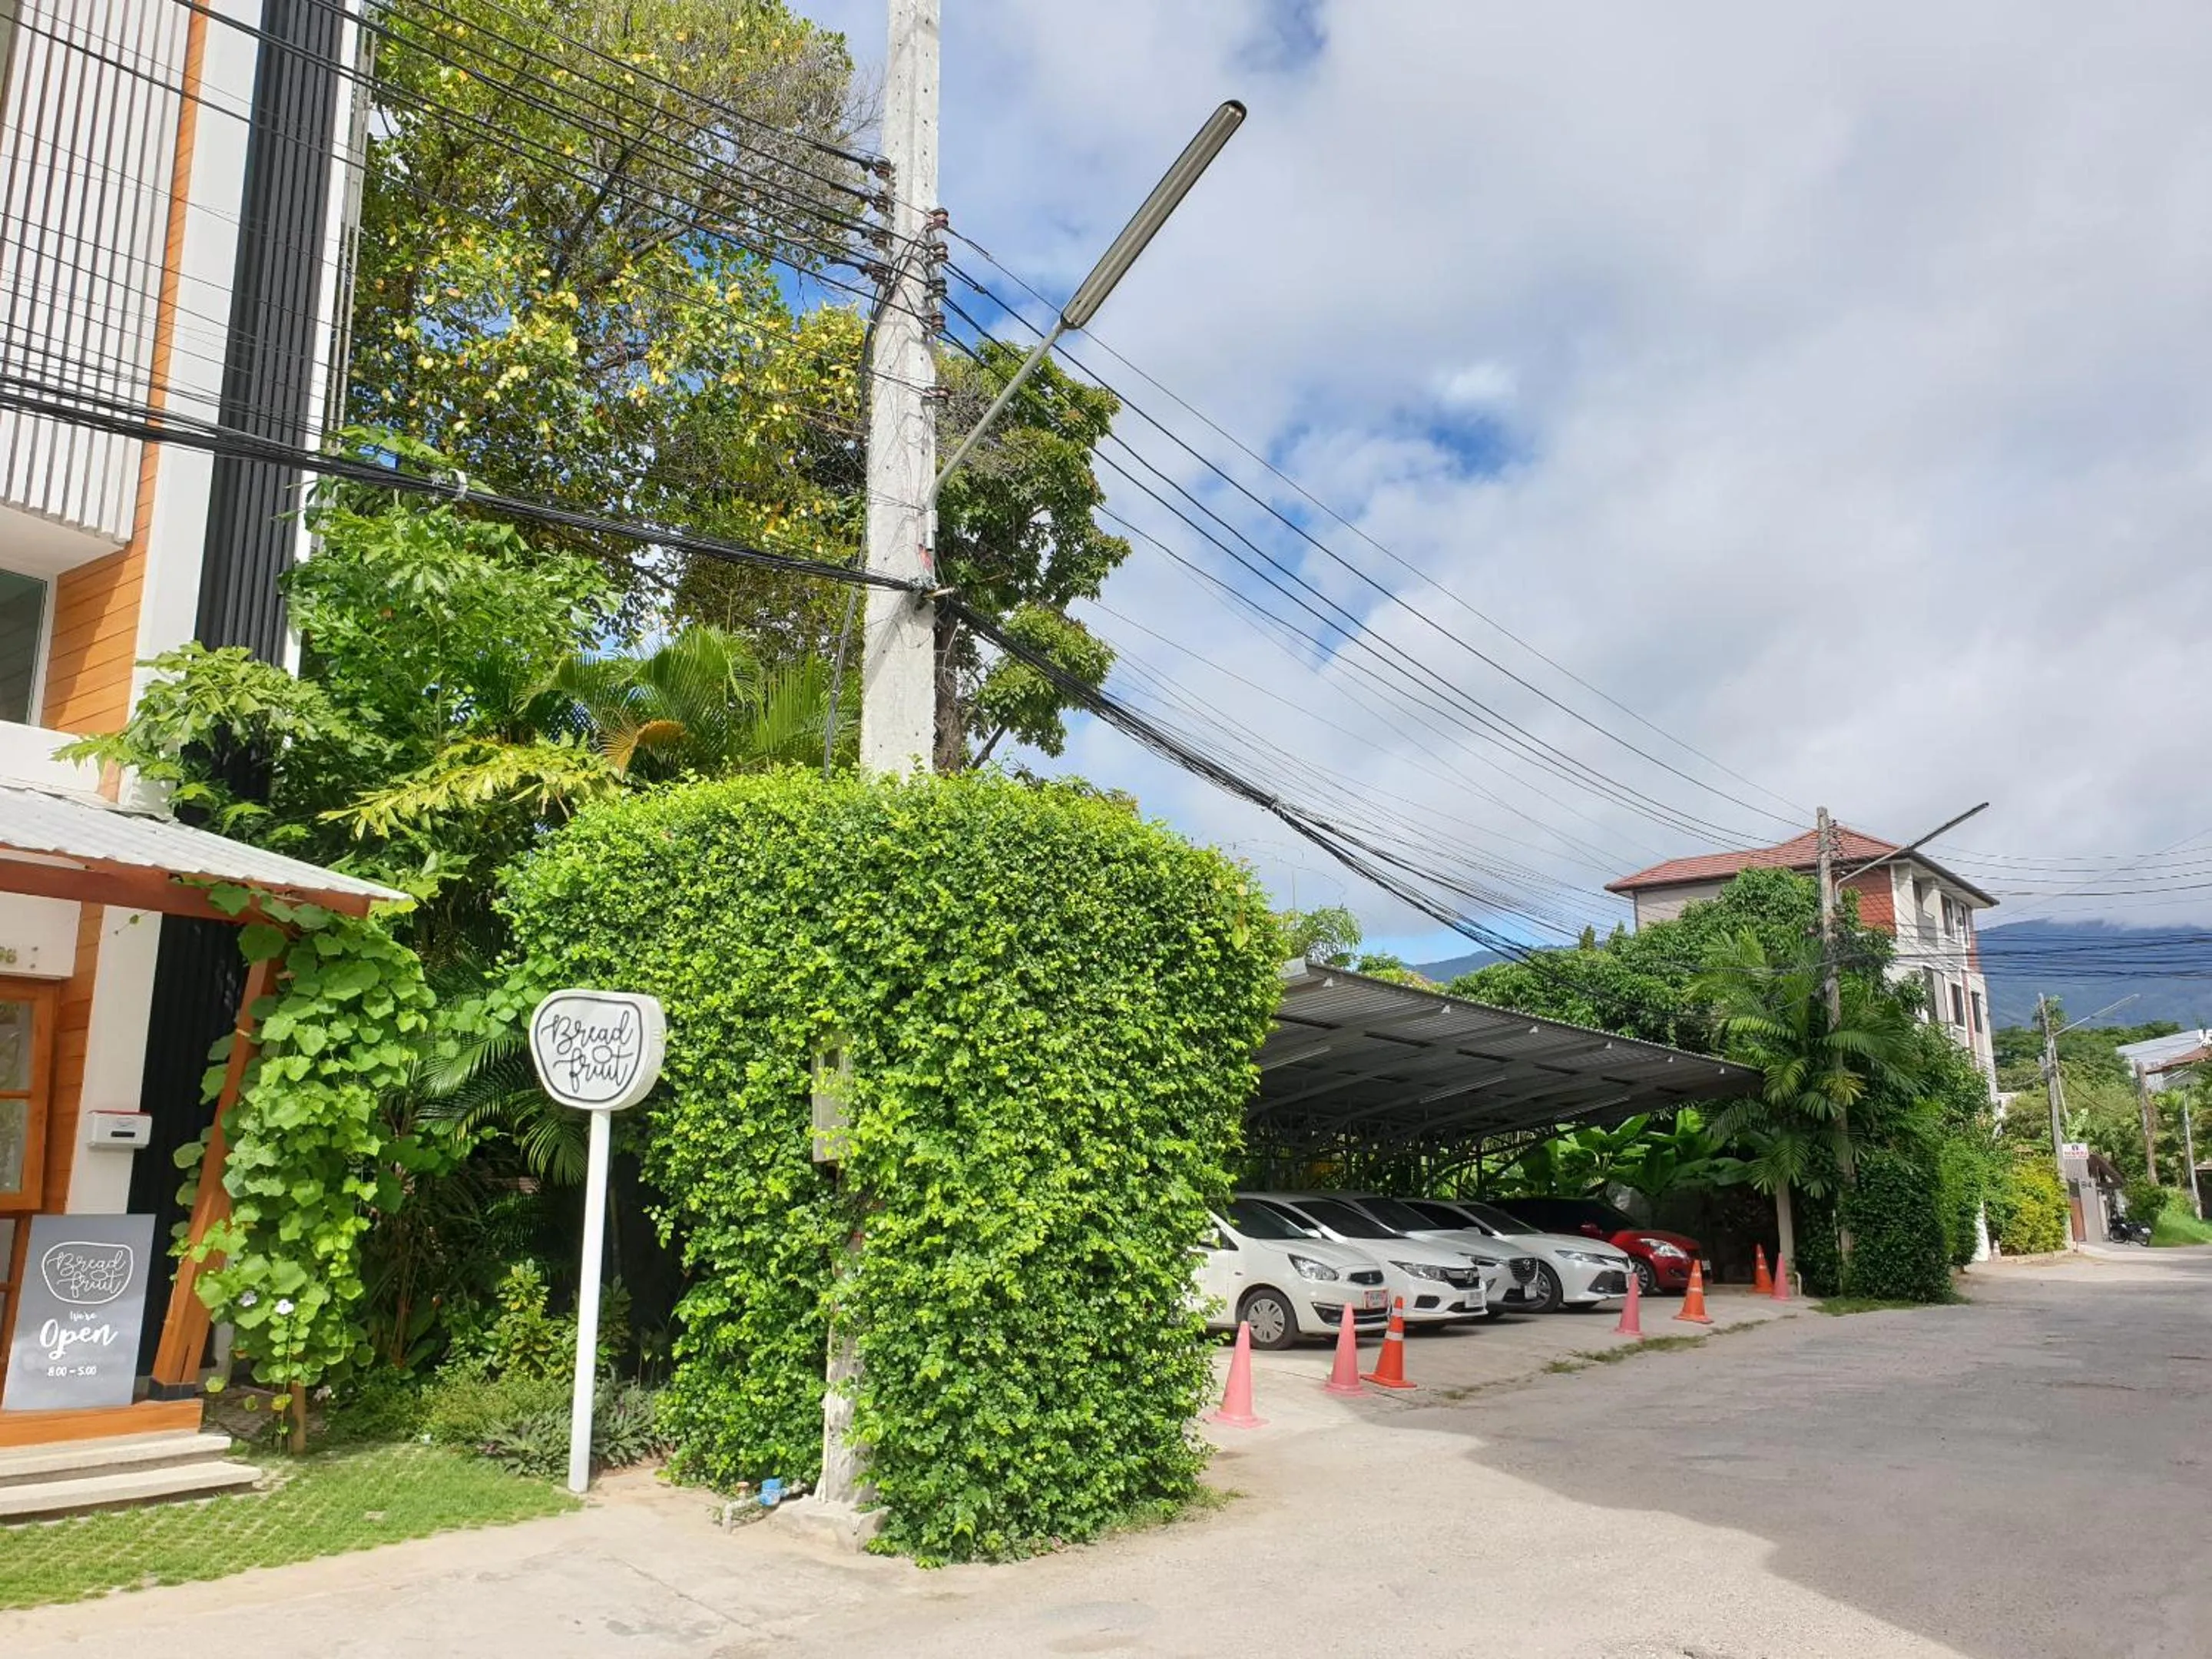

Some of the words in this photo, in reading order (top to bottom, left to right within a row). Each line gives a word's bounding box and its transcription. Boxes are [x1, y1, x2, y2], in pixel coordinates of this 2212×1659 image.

[541, 1010, 633, 1055] Bread
[47, 1250, 126, 1277] Bread
[39, 1319, 119, 1360] Open
